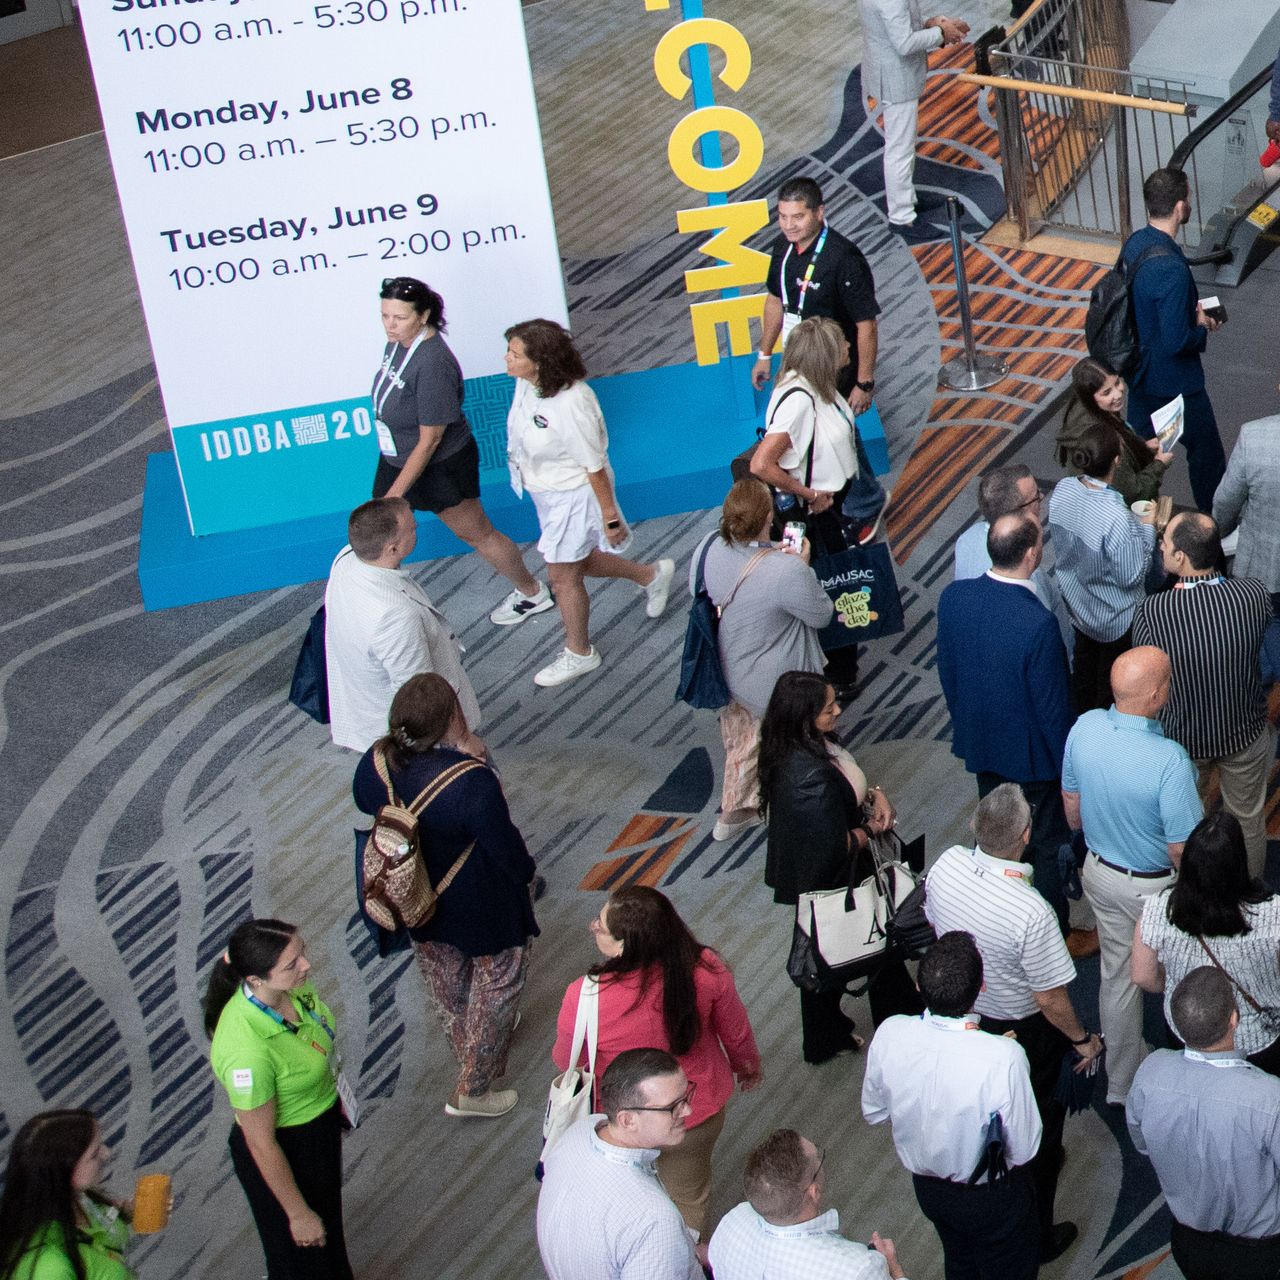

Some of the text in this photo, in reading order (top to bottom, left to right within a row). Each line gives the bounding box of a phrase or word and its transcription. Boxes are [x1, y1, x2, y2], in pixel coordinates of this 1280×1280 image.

[117, 21, 202, 53] 11:00
[214, 17, 283, 41] a.m.
[135, 77, 413, 135] Monday, June 8
[143, 141, 226, 173] 11:00
[238, 137, 305, 161] a.m.
[346, 115, 419, 146] 5:30
[431, 111, 497, 141] p.m.
[160, 193, 439, 253] Tuesday, June 9
[168, 257, 260, 291] 10:00
[272, 252, 337, 276] a.m.
[377, 229, 451, 261] 2:00
[462, 224, 527, 253] p.m.
[200, 421, 292, 462] IDDBA
[820, 569, 874, 588] MAUSAC
[837, 591, 867, 610] glaze
[846, 602, 865, 615] the
[847, 612, 869, 625] day
